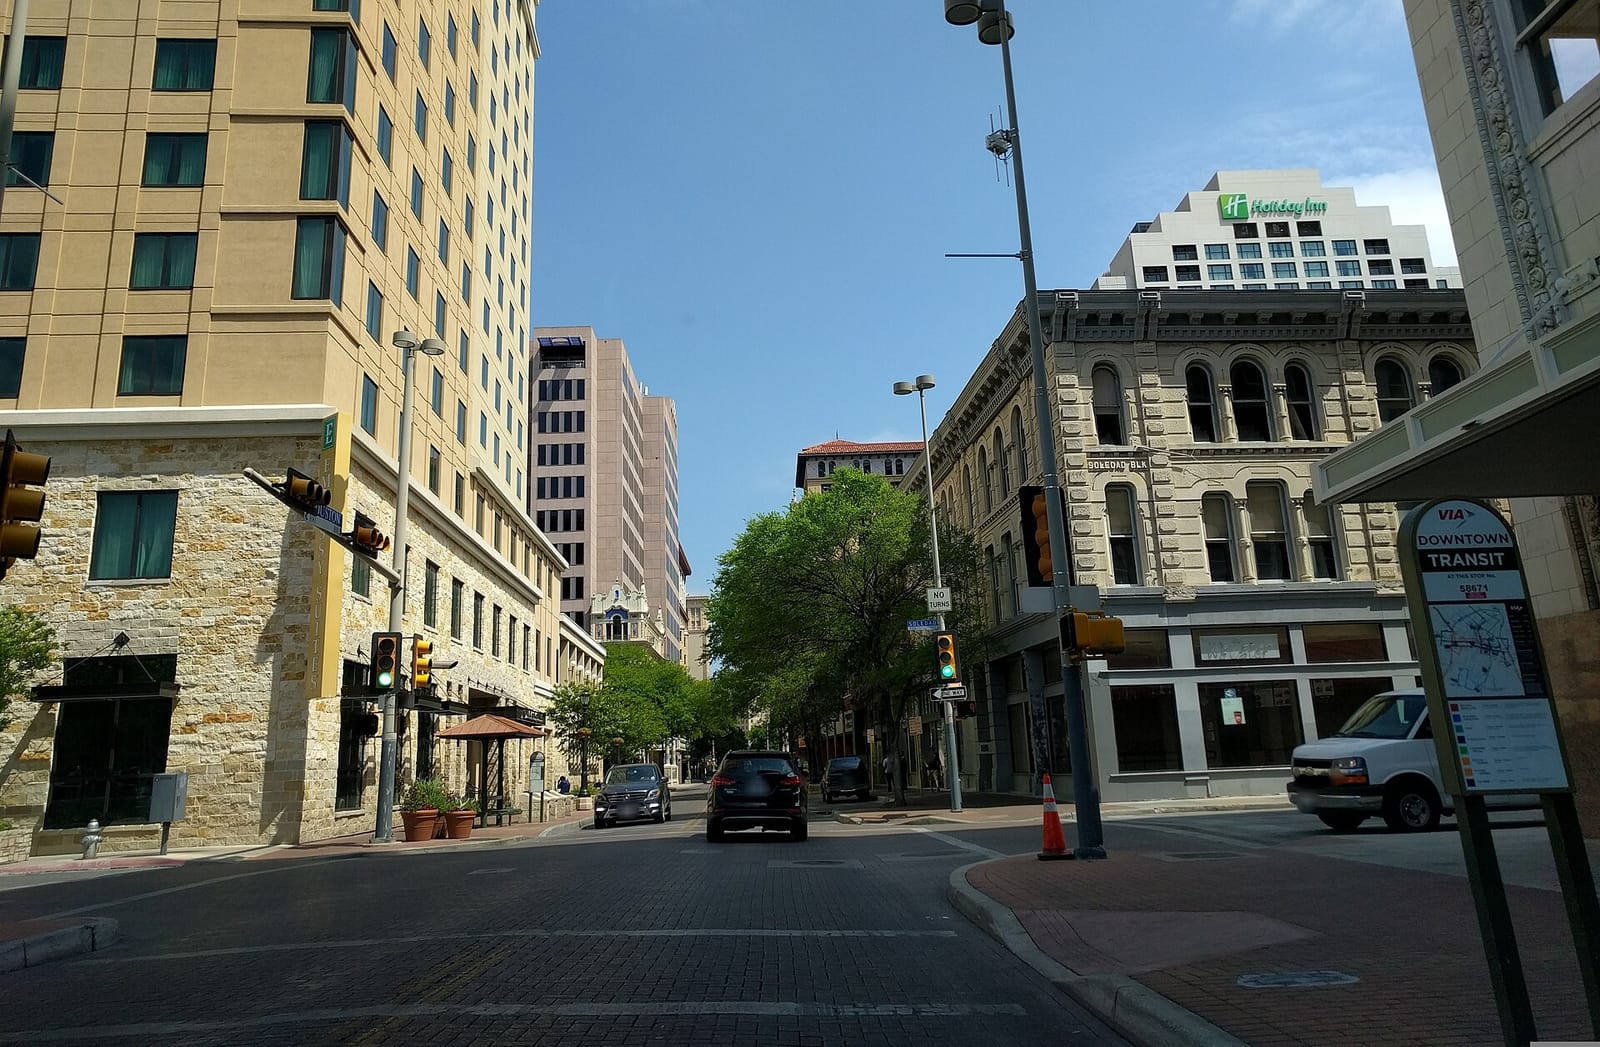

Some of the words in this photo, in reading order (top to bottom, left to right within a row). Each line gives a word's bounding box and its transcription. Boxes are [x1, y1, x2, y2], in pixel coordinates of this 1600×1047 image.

[1251, 200, 1304, 214] Holiday
[1305, 198, 1328, 211] Inn
[1088, 461, 1126, 469] SOLEDAD
[1130, 461, 1147, 469] BLK
[1439, 509, 1465, 520] VIA
[1418, 533, 1509, 546] DOWNTOWN
[1427, 552, 1504, 568] TRANSIT
[933, 591, 945, 599] NO
[311, 586, 323, 689] SUITES
